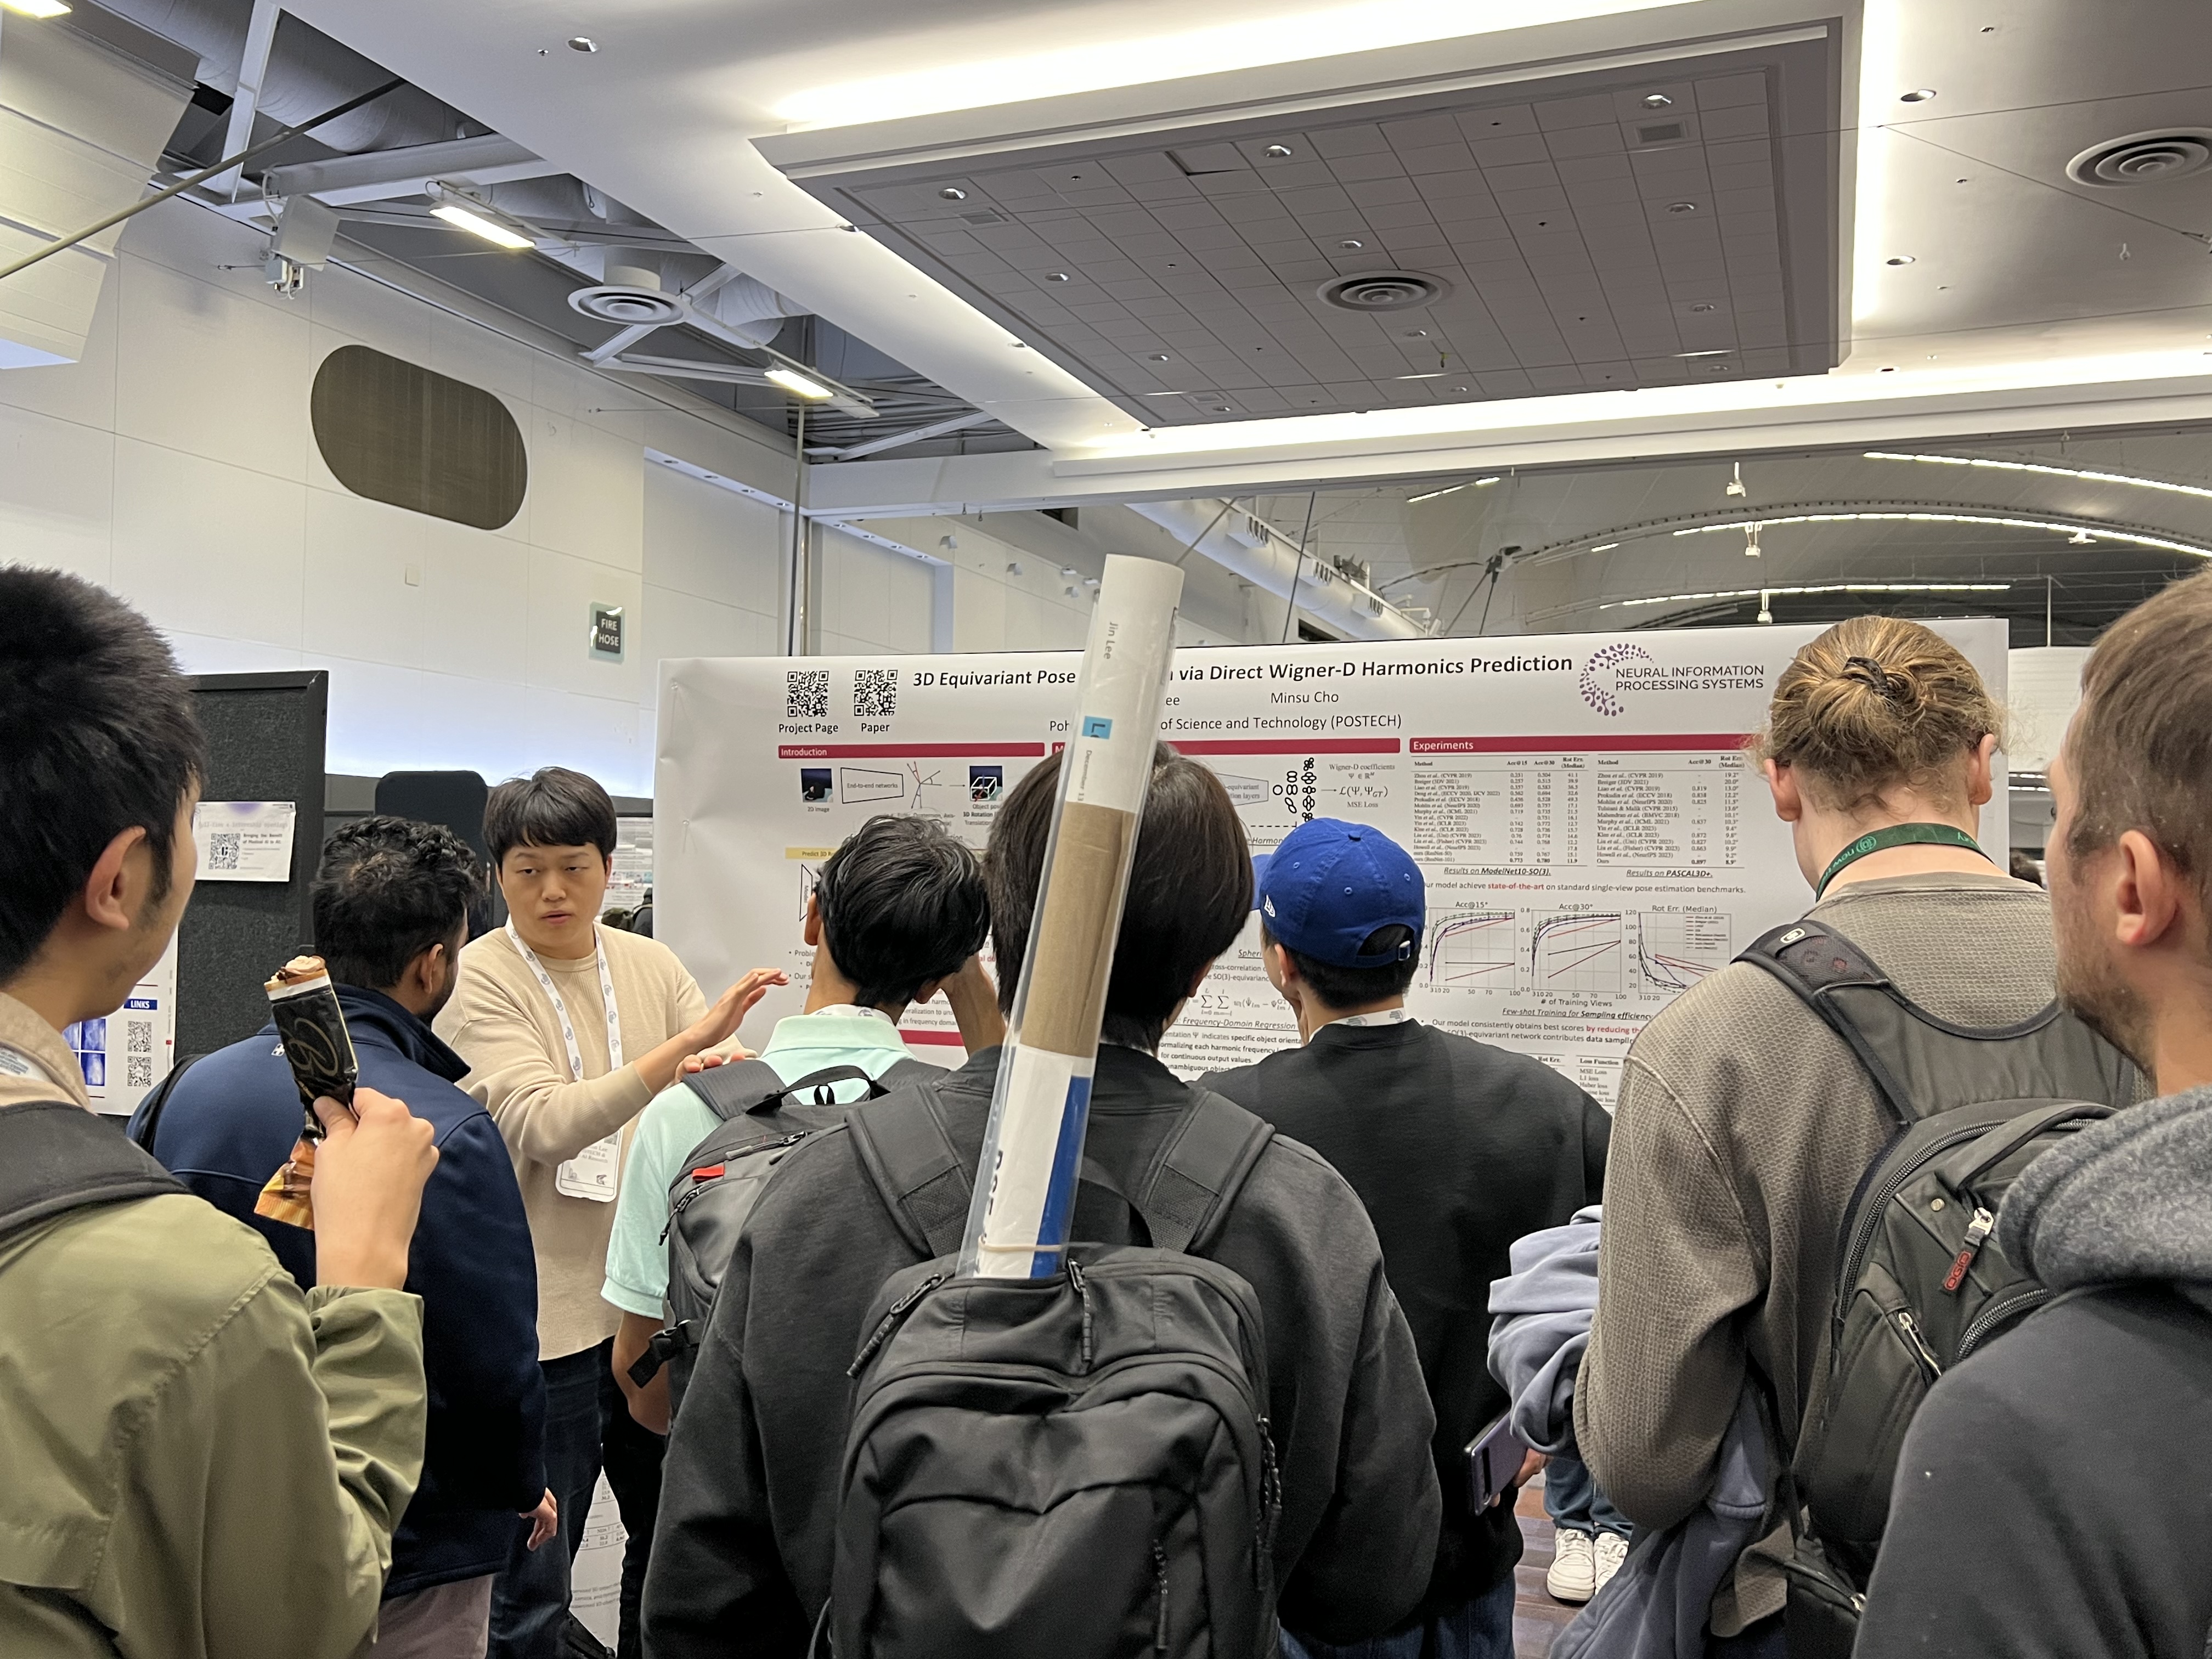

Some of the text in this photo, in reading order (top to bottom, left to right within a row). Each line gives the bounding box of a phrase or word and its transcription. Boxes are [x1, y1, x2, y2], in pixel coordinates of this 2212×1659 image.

[601, 618, 617, 631] FIRE
[599, 633, 619, 646] HOSE
[1103, 621, 1118, 660] Jin Lee
[913, 672, 934, 686] 3D
[940, 670, 1032, 689] Equivariant
[1037, 670, 1076, 684] Pose
[1179, 666, 1204, 680] via
[1210, 665, 1263, 680] Direct
[1269, 662, 1356, 681] Wigner-D
[1362, 658, 1464, 676] Harmonics
[1470, 655, 1573, 674] Prediction
[1616, 665, 1764, 678] NEURAL INFORMATION
[1616, 678, 1764, 691] PROCESSING SYSTEMS
[1271, 691, 1339, 704] Minsu Cho
[1160, 714, 1402, 731] of Science and Technology (POSTECH)
[778, 723, 838, 735] Project Page
[861, 723, 890, 734] Paper
[1413, 740, 1474, 752] Experiments
[781, 747, 827, 757] Introduction
[1329, 763, 1358, 771] Wigner-D
[1481, 867, 1551, 877] ModelNet10-SO(3).
[1459, 882, 1486, 890] achieve
[1488, 883, 1544, 891] state-of-the-art
[1557, 883, 1590, 891] standard
[1592, 884, 1633, 893] single-view
[1655, 884, 1695, 893] estimation
[1697, 884, 1746, 893] benchmarks.
[130, 1000, 150, 1009] LINKS
[1538, 1009, 1567, 1017] Training
[1581, 1011, 1615, 1019] Sampling
[910, 1018, 938, 1026] frequency
[1255, 1020, 1296, 1030] Regression
[1471, 1020, 1514, 1029] consistently
[1515, 1022, 1542, 1030] obtains
[1587, 1025, 1595, 1033] by
[1597, 1026, 1629, 1035] reducing
[1256, 1036, 1277, 1044] object
[1543, 1034, 1584, 1042] contributes
[1211, 1043, 1241, 1052] harmonic
[1207, 1054, 1229, 1063] output
